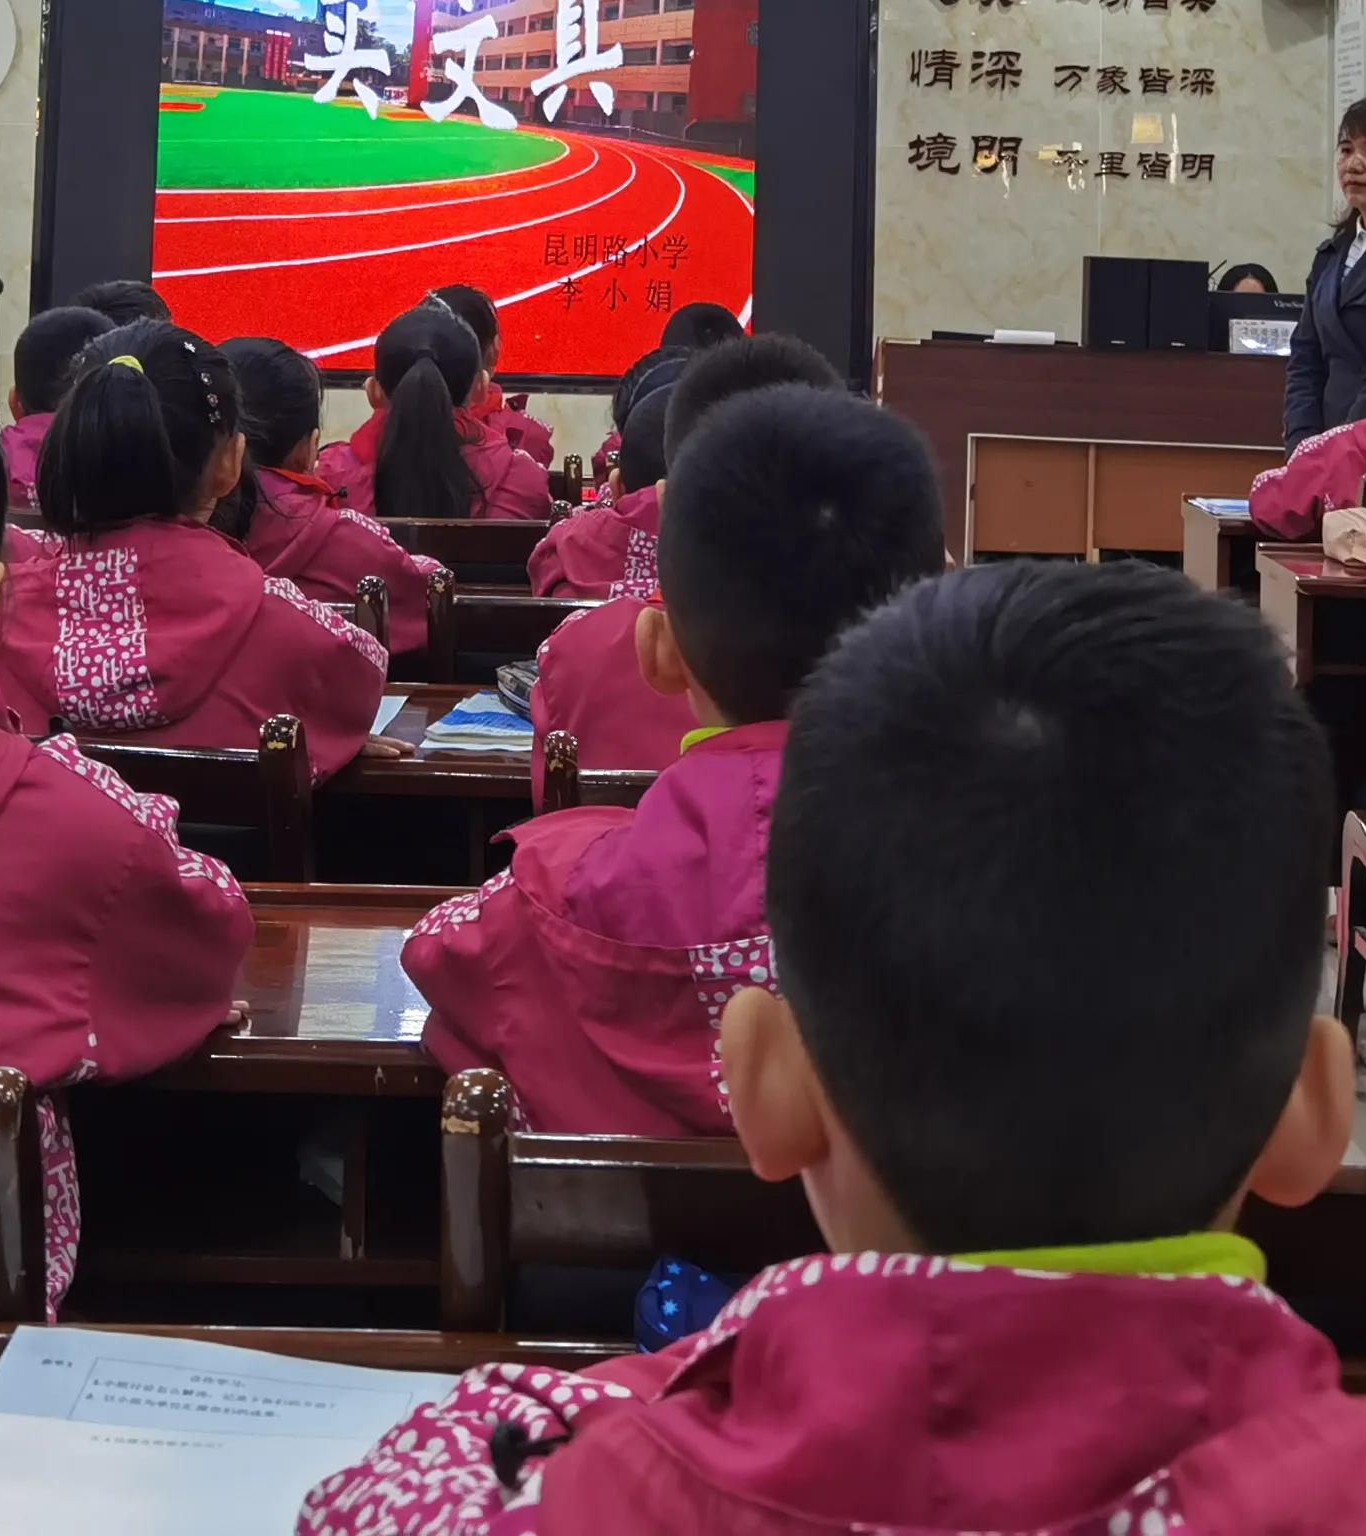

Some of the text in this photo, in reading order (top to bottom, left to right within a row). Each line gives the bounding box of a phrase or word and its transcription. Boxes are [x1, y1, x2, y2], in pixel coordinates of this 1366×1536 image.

[909, 49, 1215, 96] 情深 万象皆深
[908, 132, 1023, 176] 境明
[544, 233, 689, 270] 昆明路小学
[555, 276, 672, 313] 李小娟
